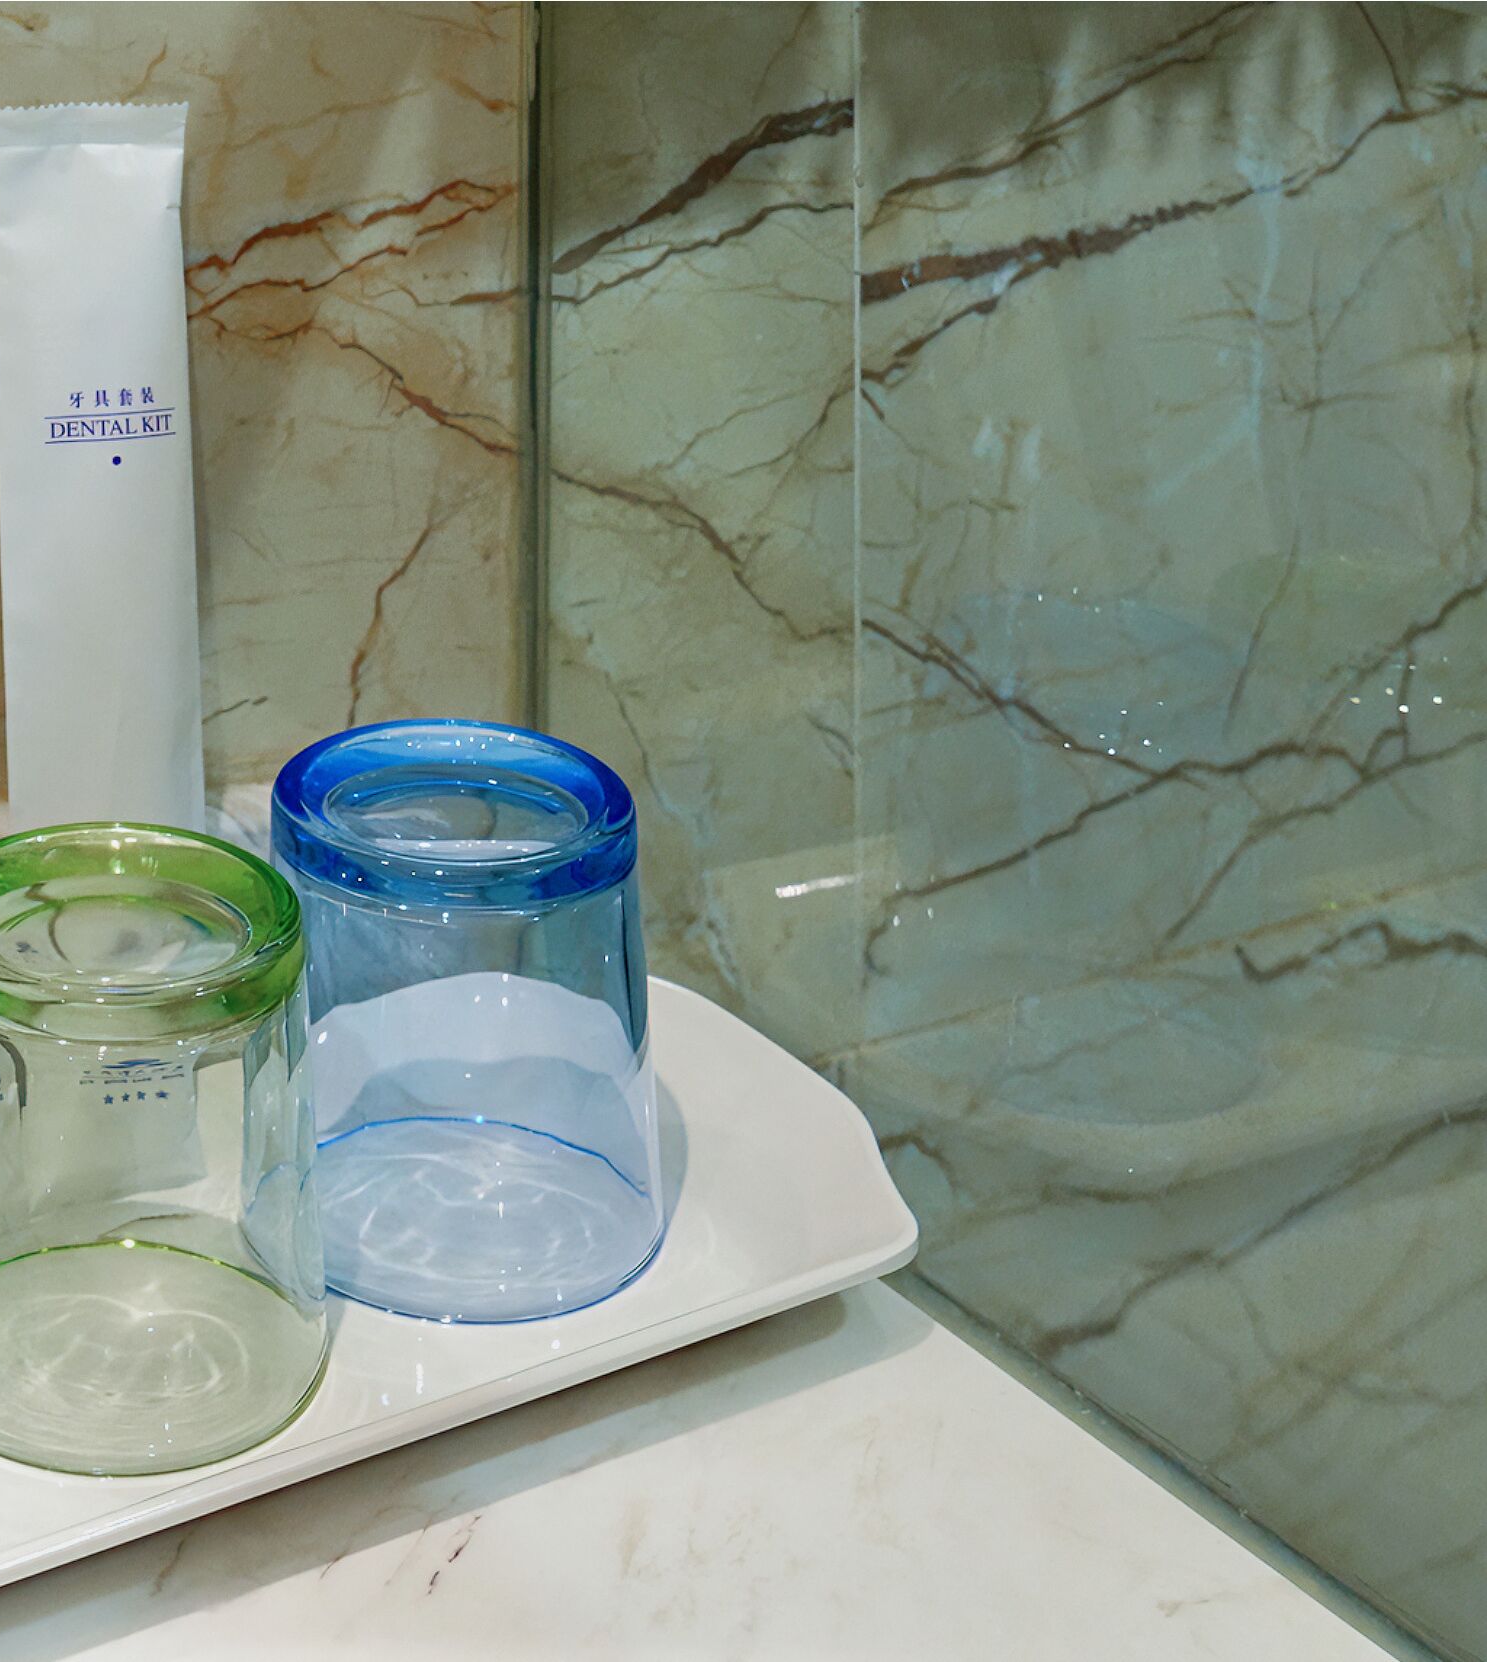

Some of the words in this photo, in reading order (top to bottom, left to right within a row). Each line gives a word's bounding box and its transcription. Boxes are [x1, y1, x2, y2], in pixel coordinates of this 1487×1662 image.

[69, 386, 154, 408] 牙具套装
[51, 418, 138, 439] DENTAL
[142, 414, 172, 433] KIT
